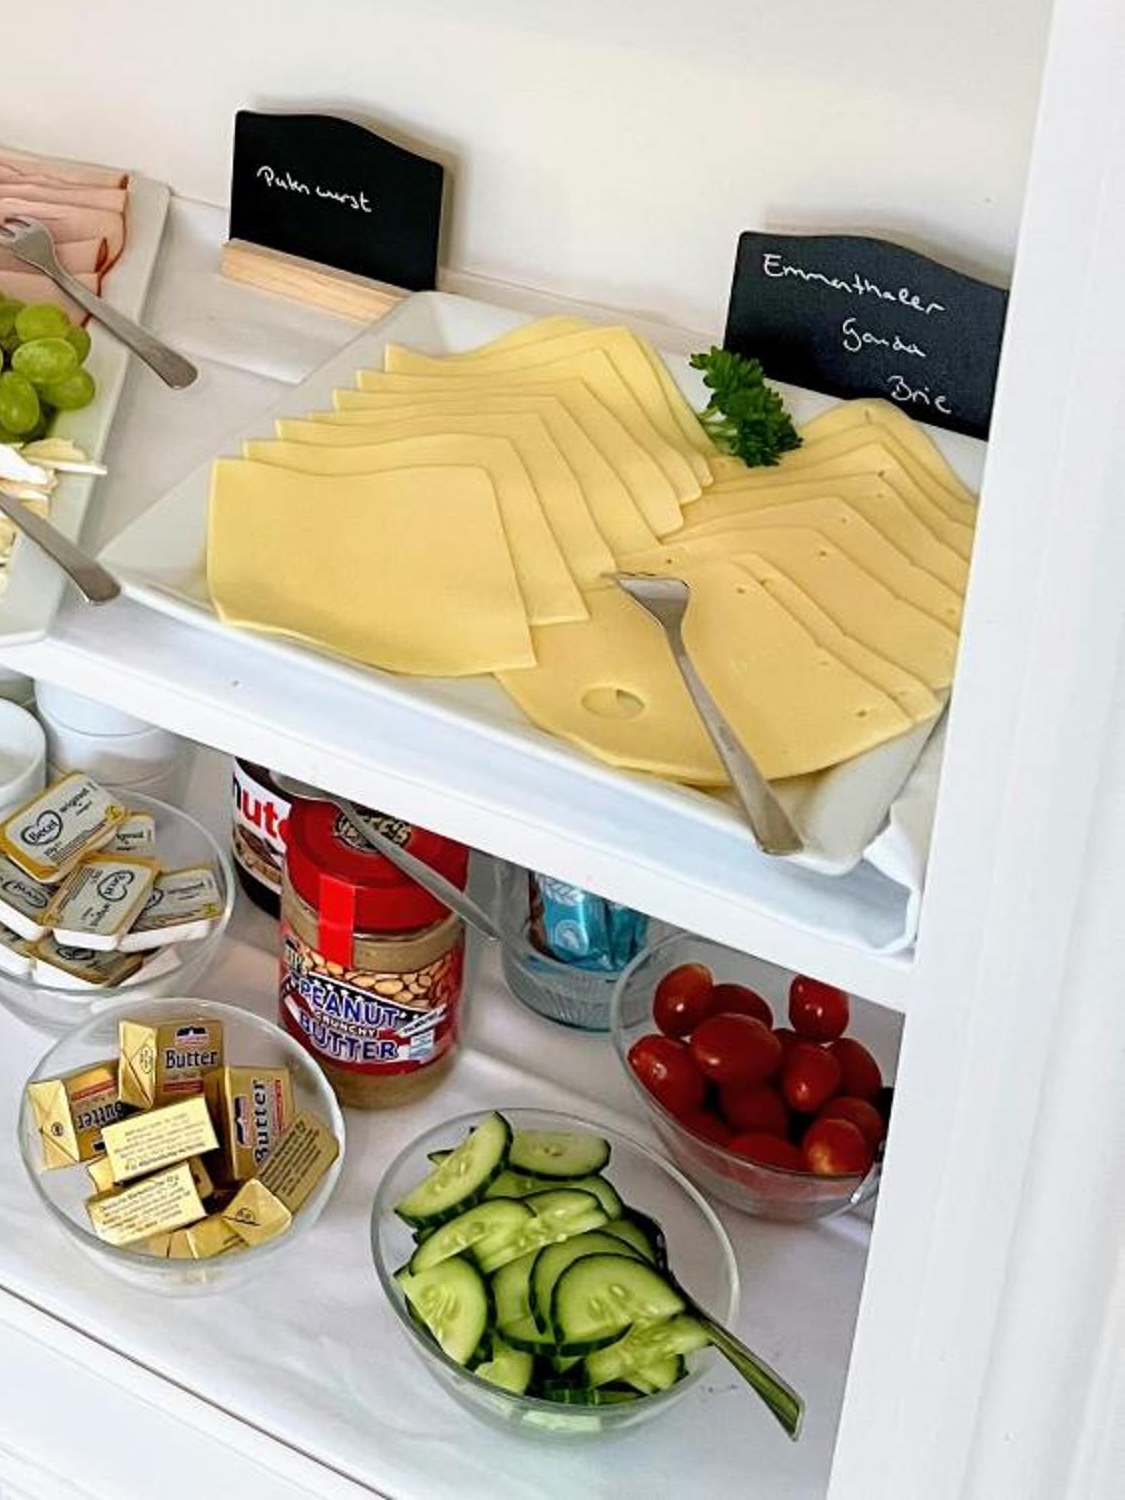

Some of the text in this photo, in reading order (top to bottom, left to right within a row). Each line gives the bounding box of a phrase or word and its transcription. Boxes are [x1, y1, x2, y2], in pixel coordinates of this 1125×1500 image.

[886, 374, 952, 415] Brie
[299, 978, 401, 1027] PEANUT
[165, 1049, 218, 1070] Butter
[298, 1010, 400, 1061] BUTTER
[251, 1078, 269, 1164] Butter
